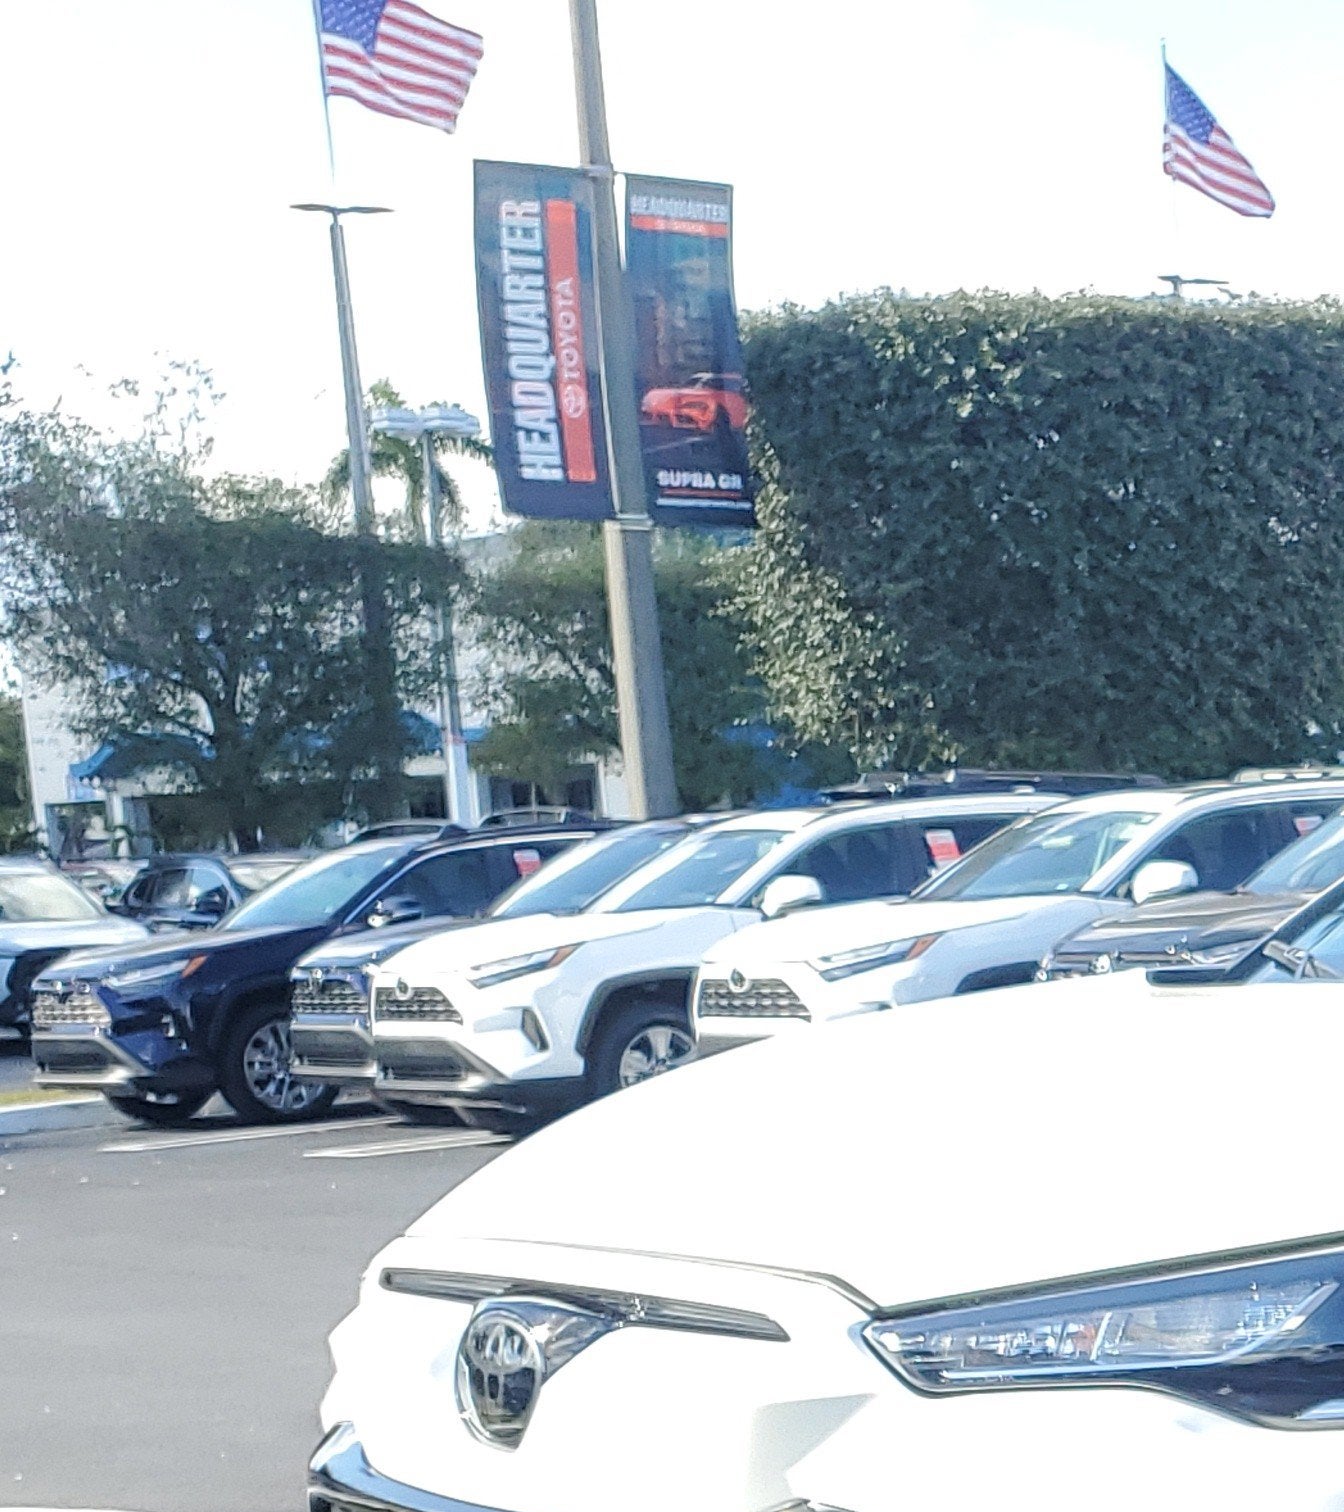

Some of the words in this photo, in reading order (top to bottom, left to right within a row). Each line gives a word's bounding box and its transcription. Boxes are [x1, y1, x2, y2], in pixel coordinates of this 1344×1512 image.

[500, 199, 564, 481] HEADQUARTER
[555, 277, 581, 380] TOYOTA
[657, 469, 716, 489] SUPRA
